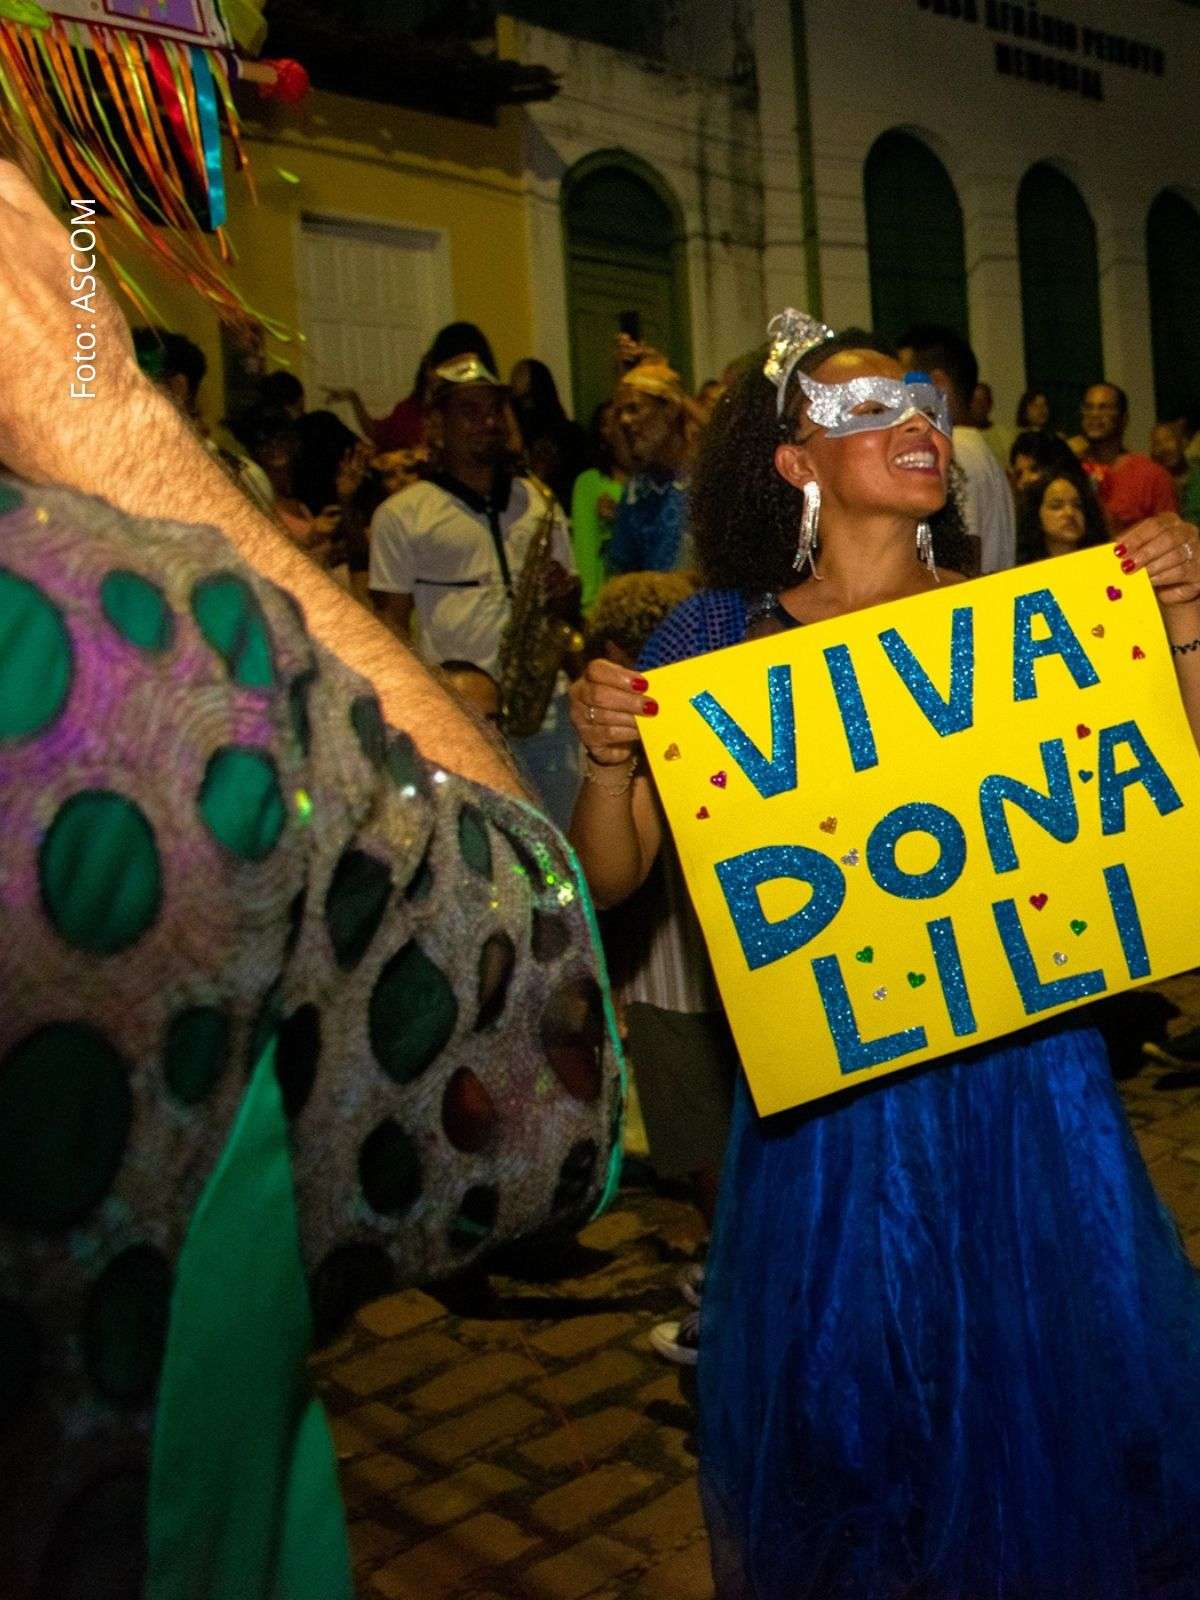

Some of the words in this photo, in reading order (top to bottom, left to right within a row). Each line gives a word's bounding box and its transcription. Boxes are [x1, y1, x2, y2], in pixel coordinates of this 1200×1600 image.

[689, 588, 1100, 799] VIVA
[715, 720, 1184, 970] DONA
[811, 863, 1151, 1075] LILI
